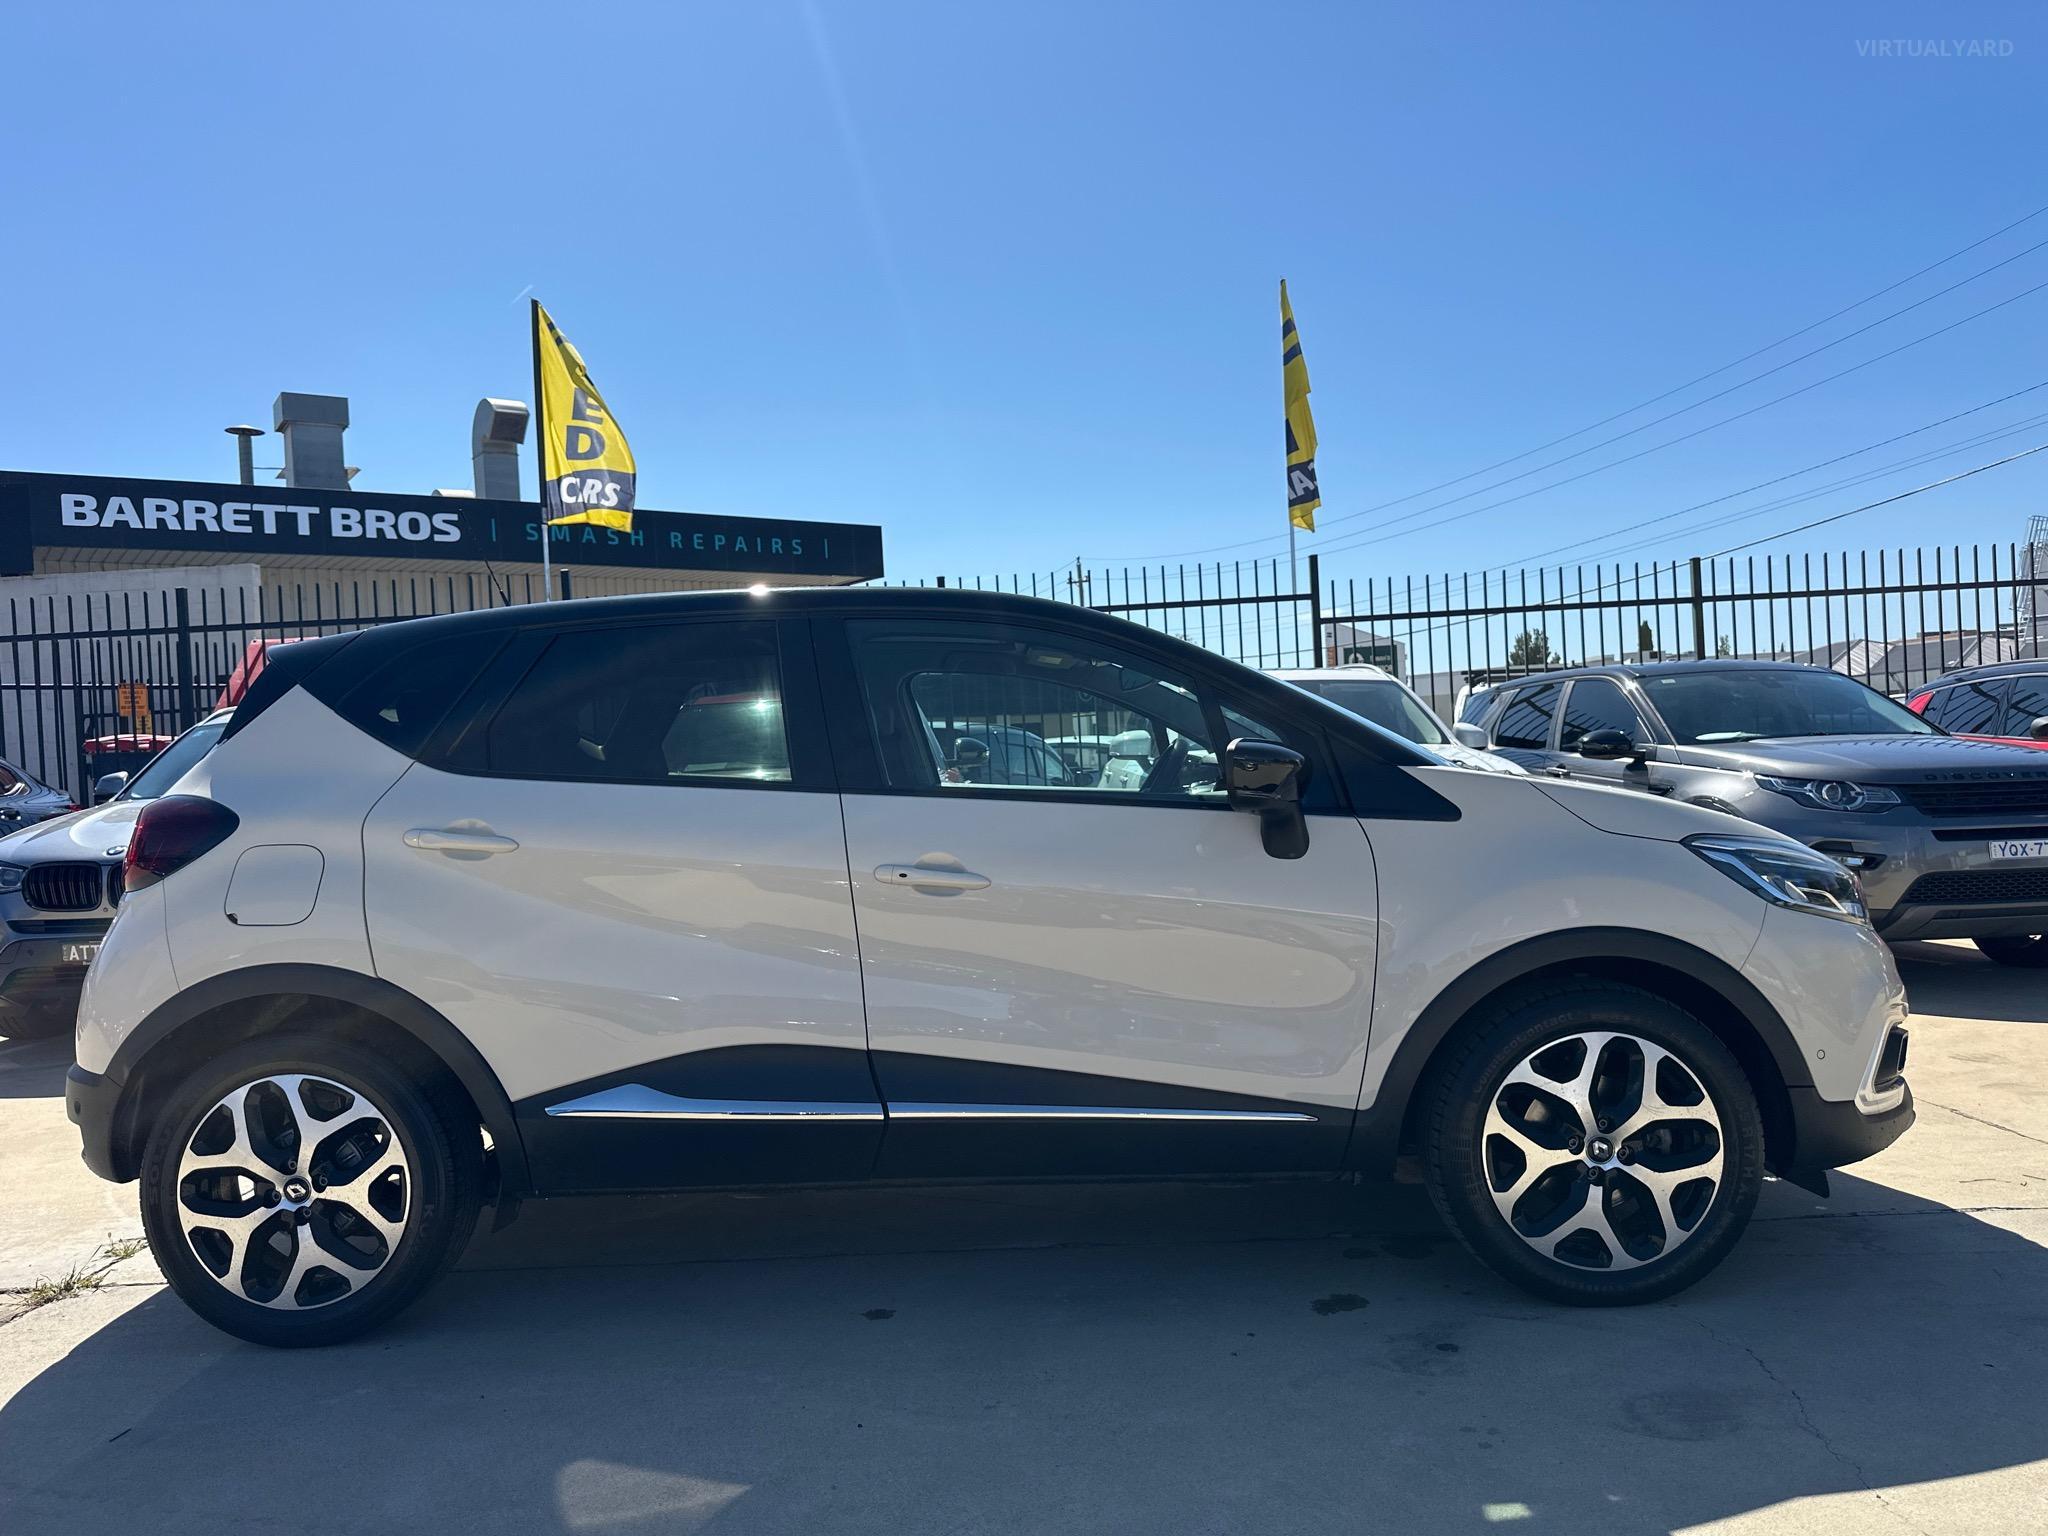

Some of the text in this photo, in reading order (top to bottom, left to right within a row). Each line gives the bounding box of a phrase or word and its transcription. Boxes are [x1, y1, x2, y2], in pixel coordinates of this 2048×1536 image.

[60, 493, 462, 542] BARRETT BROS
[526, 522, 803, 555] SMASH REPAIRS
